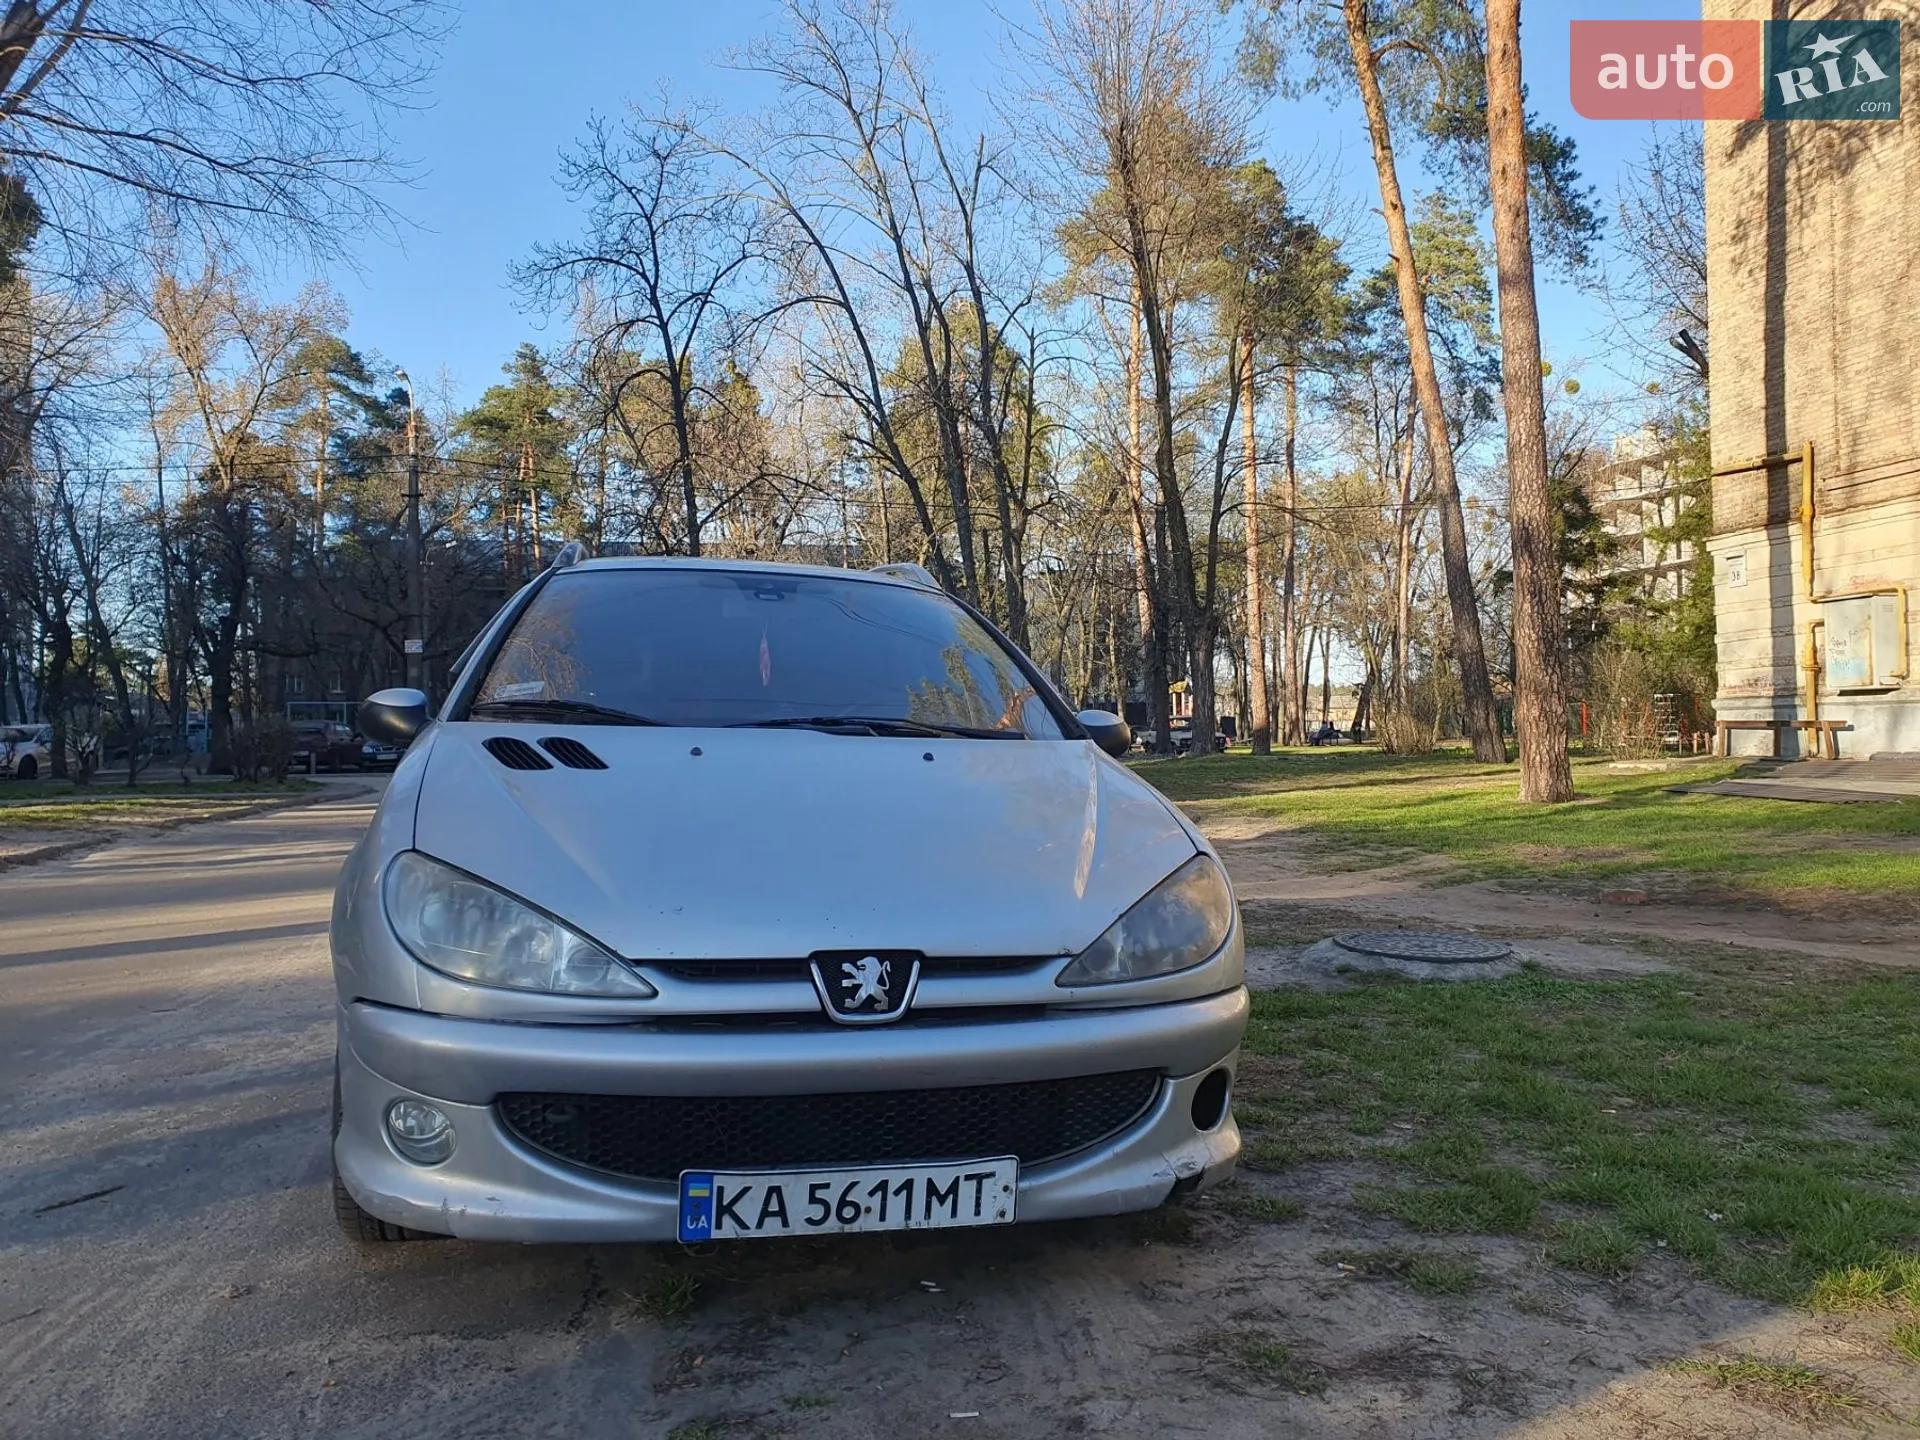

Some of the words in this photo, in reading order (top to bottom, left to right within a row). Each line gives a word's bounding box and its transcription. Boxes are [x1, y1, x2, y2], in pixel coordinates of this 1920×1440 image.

[714, 1184, 791, 1231] KA
[804, 1177, 916, 1227] 5611
[923, 1170, 997, 1220] MT
[686, 1214, 709, 1230] UA
